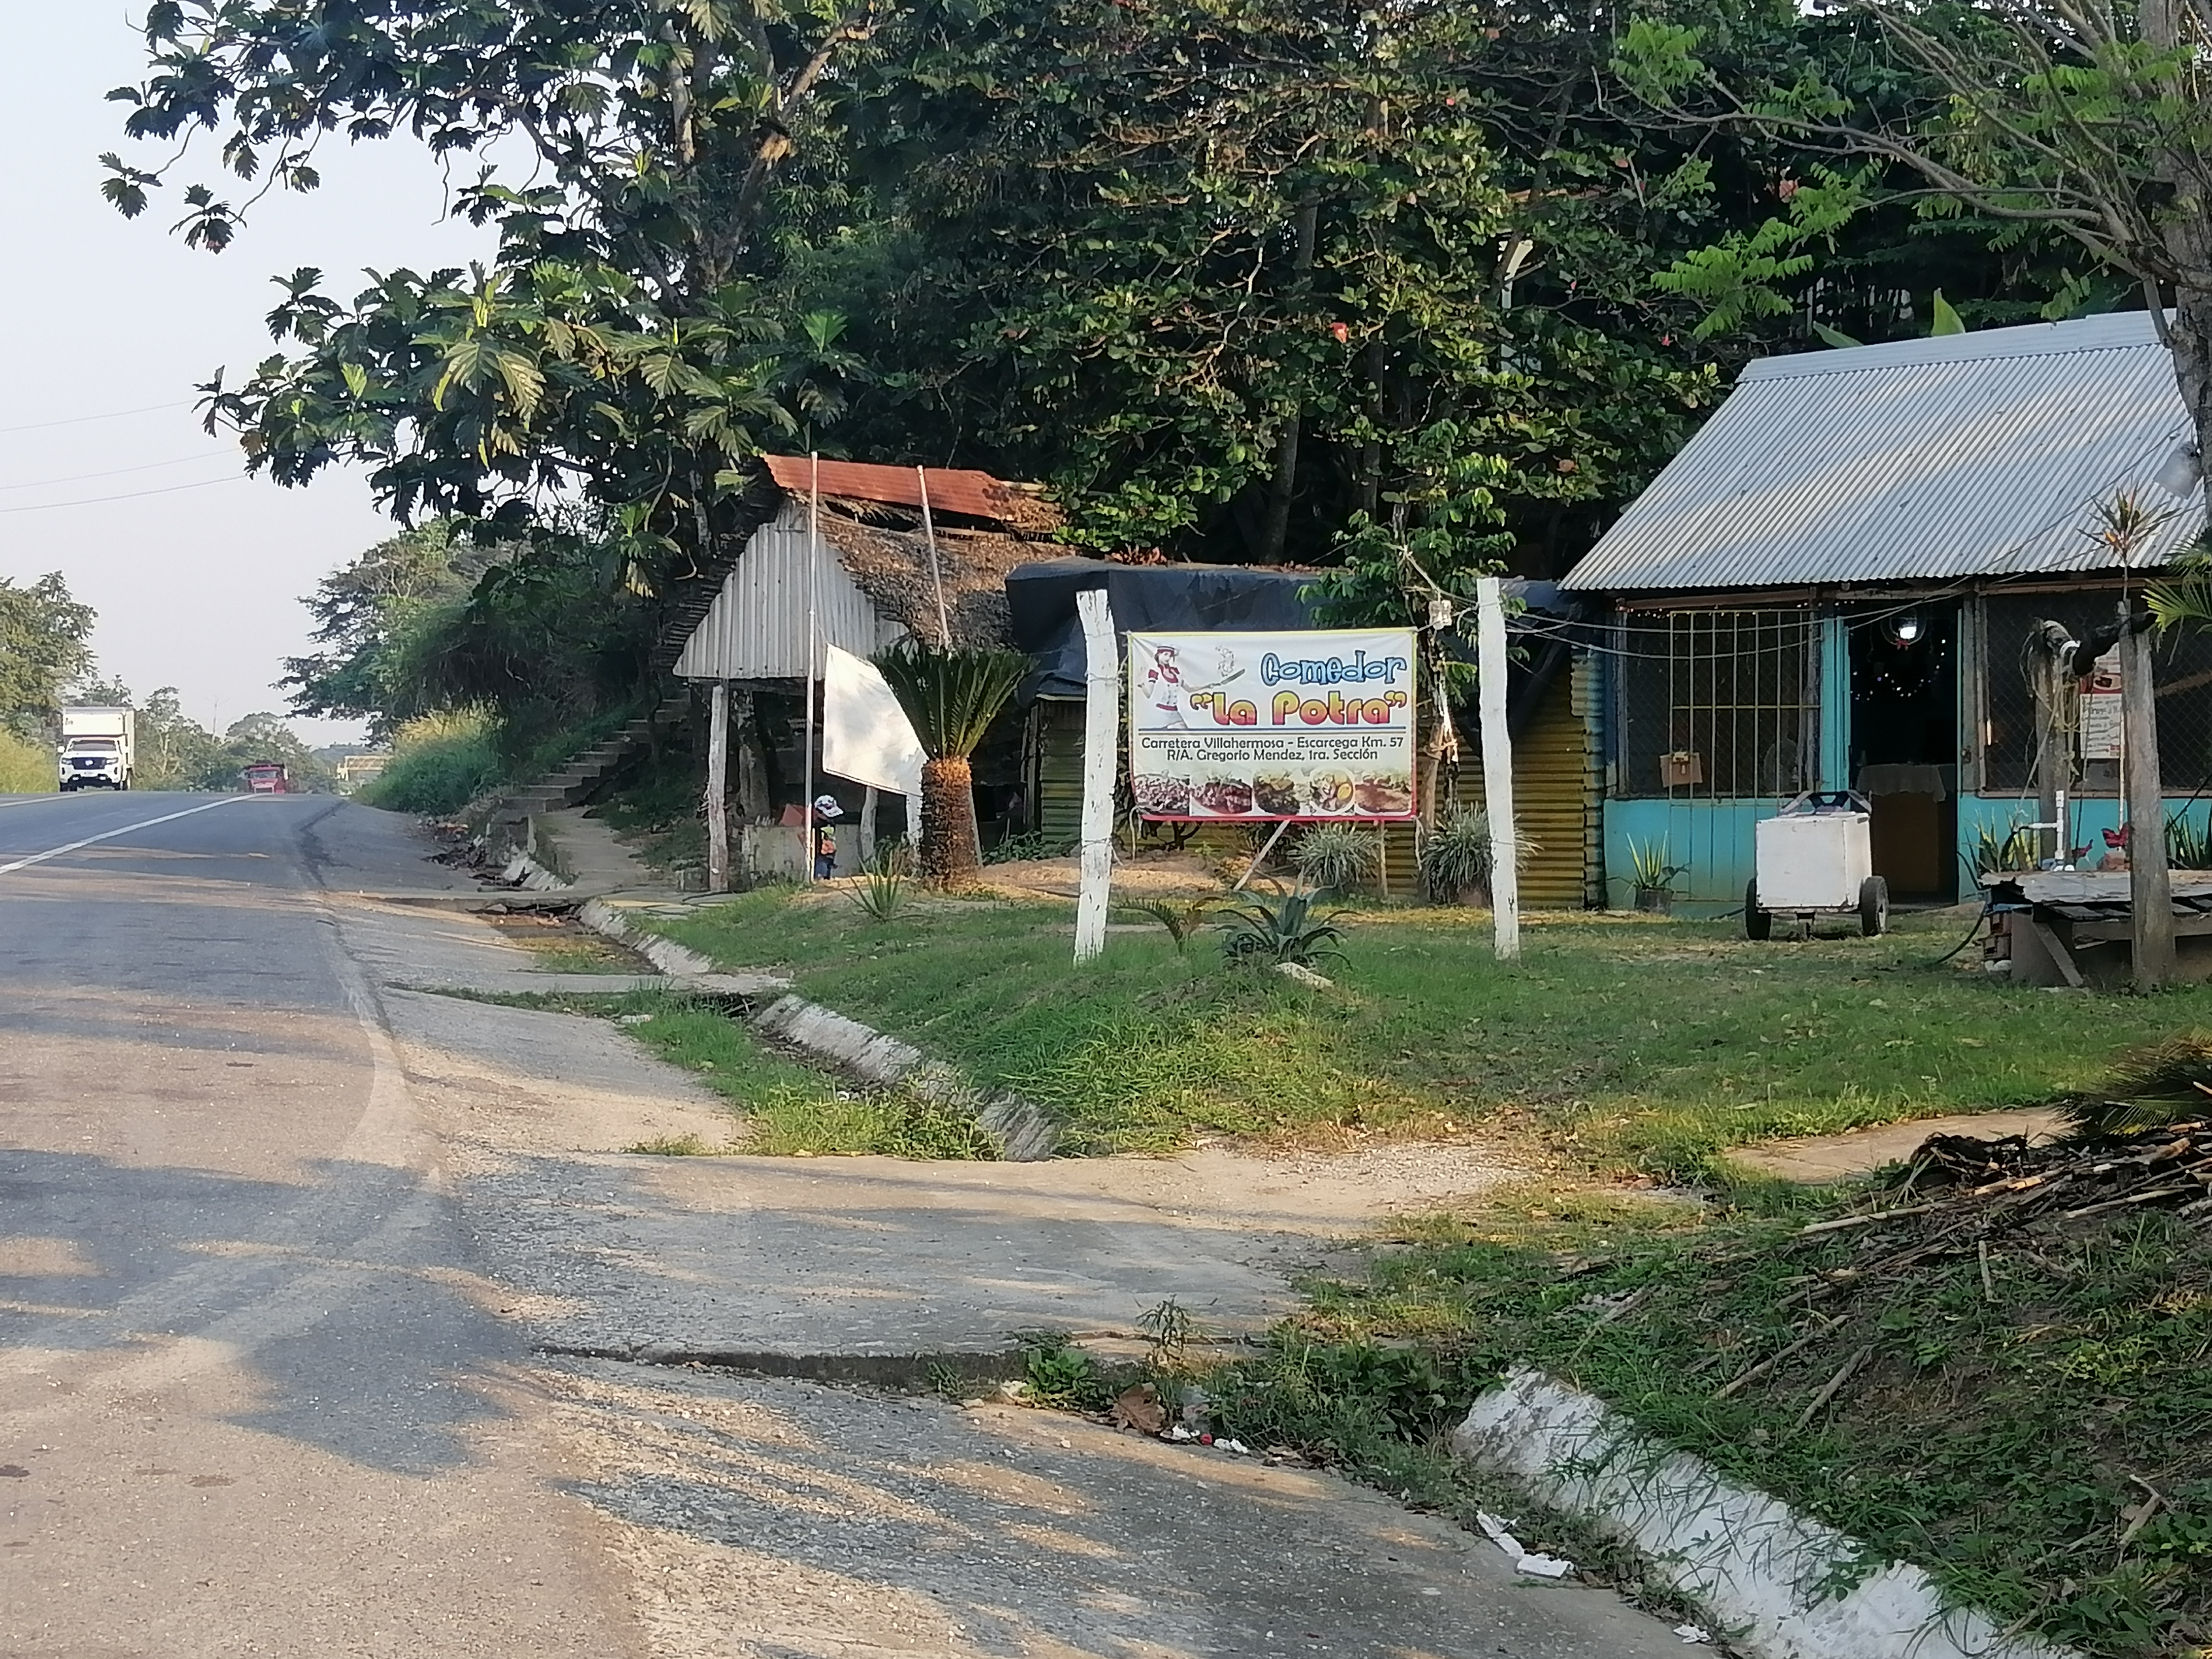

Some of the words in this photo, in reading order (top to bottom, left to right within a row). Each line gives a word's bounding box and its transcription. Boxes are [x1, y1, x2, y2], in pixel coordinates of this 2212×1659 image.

[1261, 650, 1407, 686] Comedor
[1142, 737, 1201, 748] Carretera
[1204, 737, 1284, 748] Villahermosa
[1297, 737, 1358, 749] Escarcega
[1362, 736, 1386, 747] Km.
[1390, 737, 1404, 747] 57
[1167, 749, 1193, 761] R/A.
[1197, 749, 1250, 762] Gregorio
[1253, 749, 1305, 760] Mendez,
[1333, 748, 1378, 760] Sección
